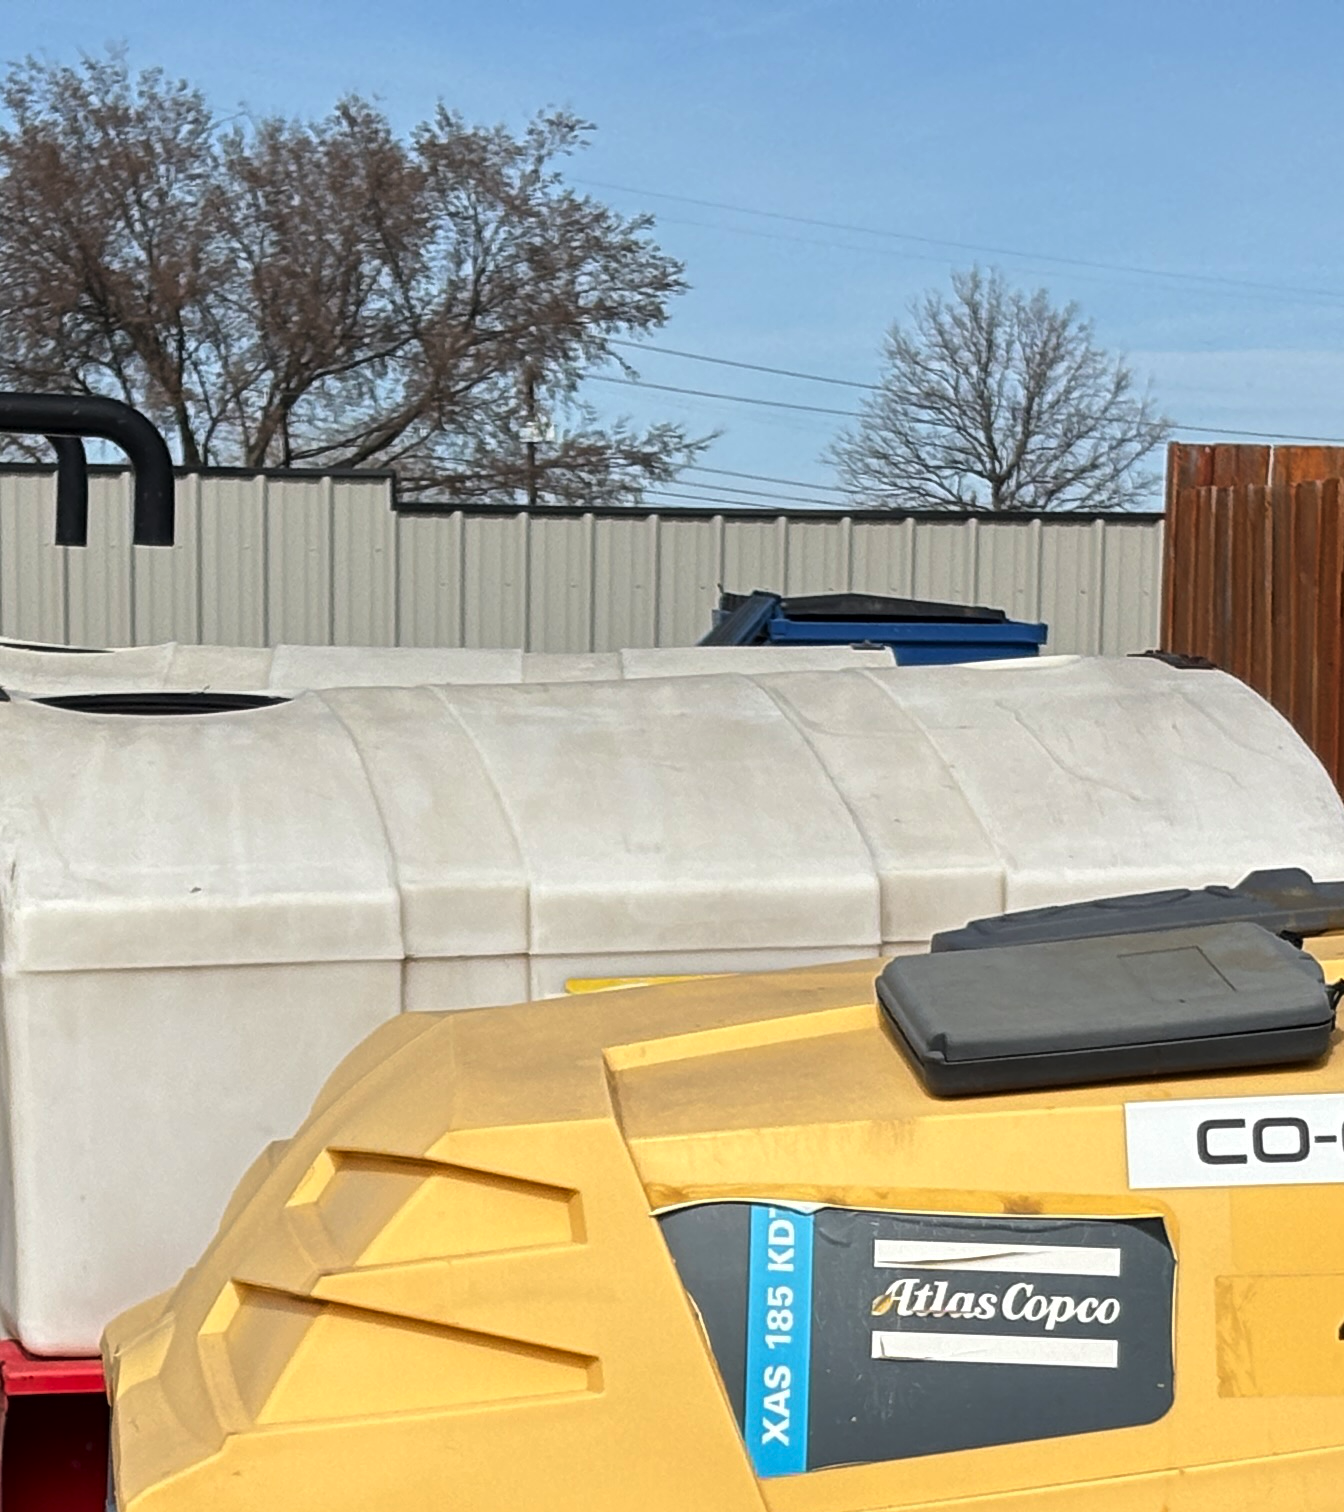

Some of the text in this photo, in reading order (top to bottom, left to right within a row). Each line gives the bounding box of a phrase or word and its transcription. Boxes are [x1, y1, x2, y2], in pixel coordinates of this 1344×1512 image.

[765, 1285, 794, 1350] 185
[871, 1278, 1121, 1331] Atlas Copco
[762, 1365, 792, 1446] XAS
